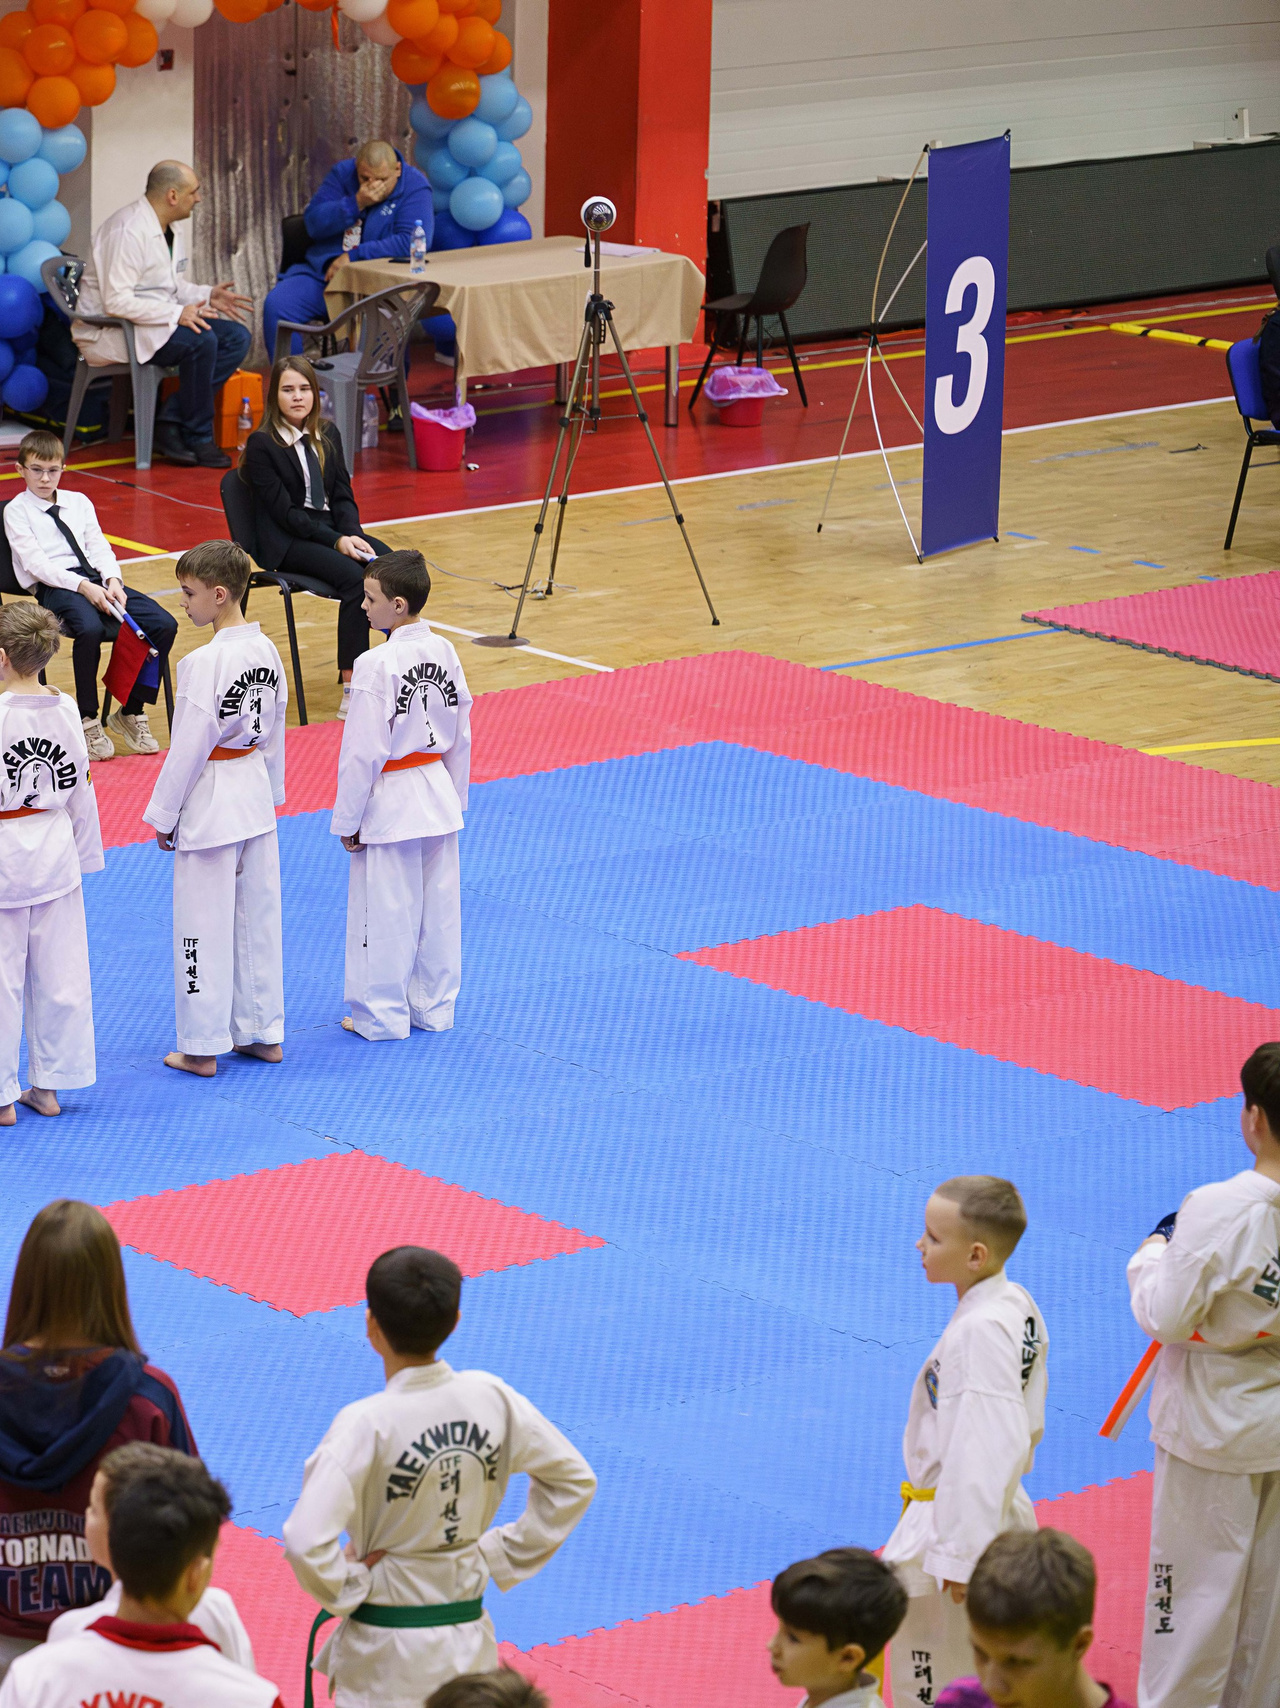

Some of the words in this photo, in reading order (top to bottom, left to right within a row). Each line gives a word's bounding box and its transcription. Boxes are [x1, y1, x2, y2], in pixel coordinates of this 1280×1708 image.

[934, 256, 996, 435] 3
[419, 685, 429, 694] TF
[183, 937, 199, 948] ITF
[439, 1454, 461, 1472] ITF
[1154, 1563, 1173, 1573] ITF
[911, 1650, 931, 1663] ITF
